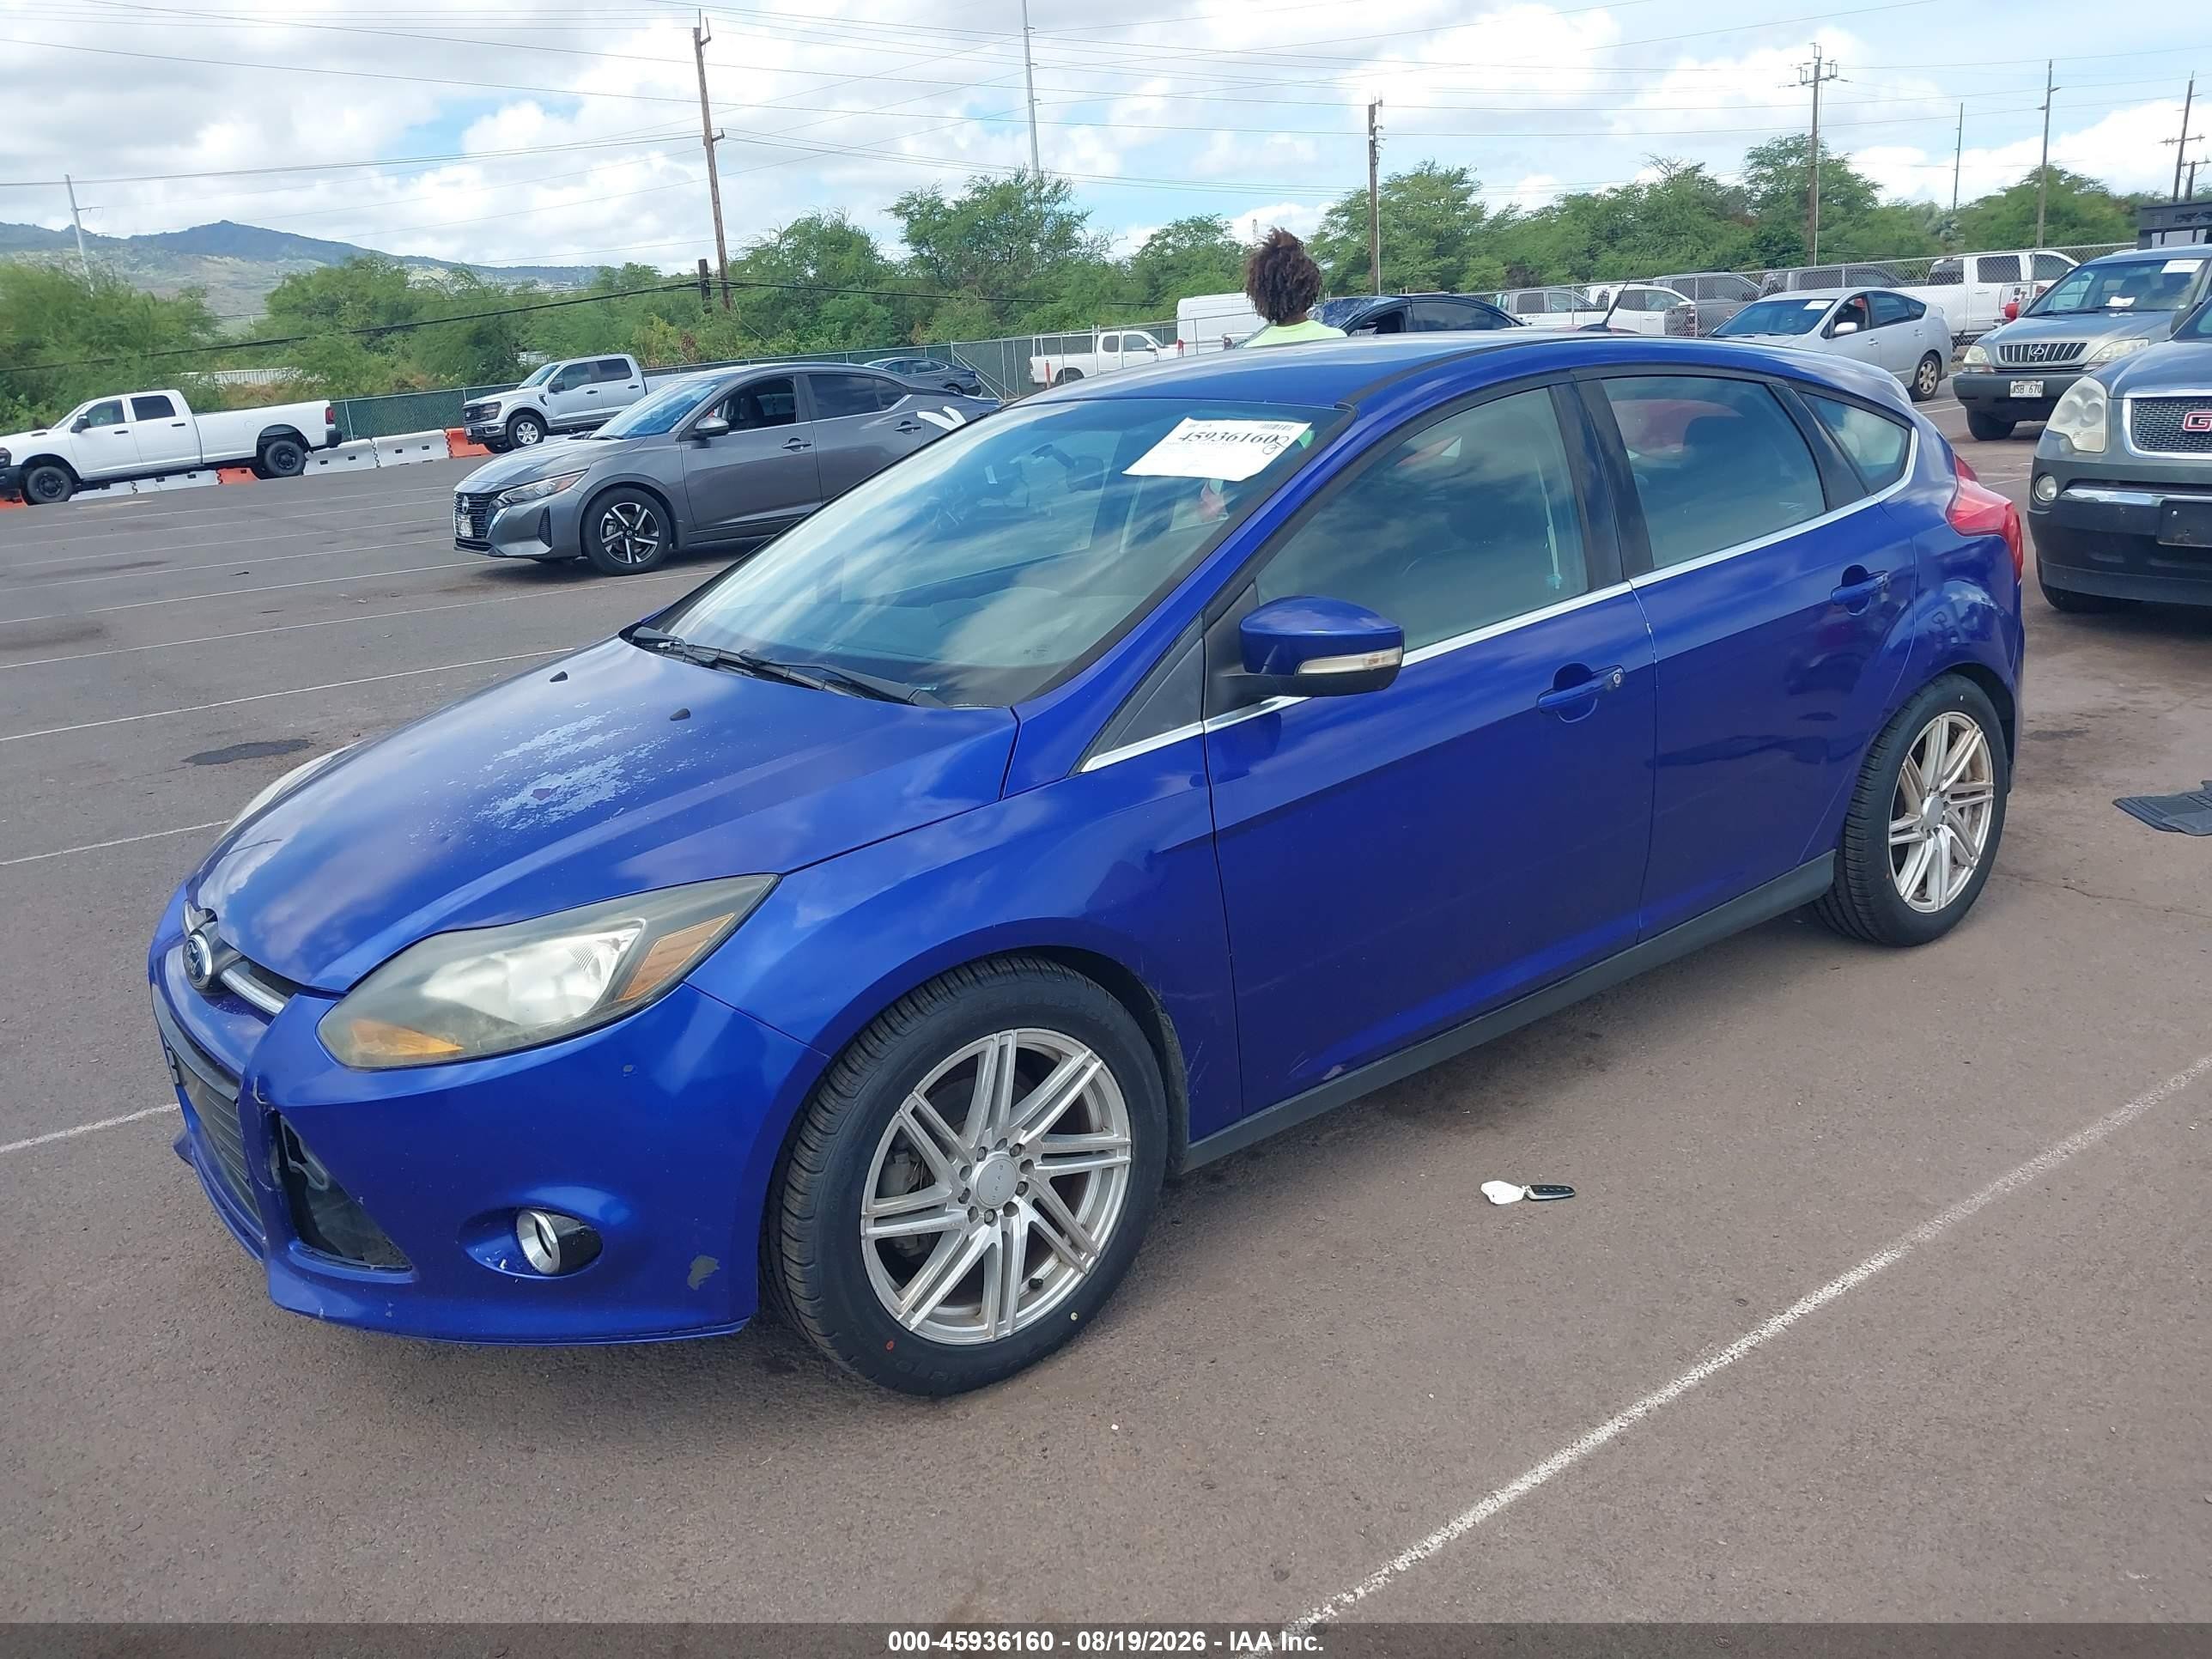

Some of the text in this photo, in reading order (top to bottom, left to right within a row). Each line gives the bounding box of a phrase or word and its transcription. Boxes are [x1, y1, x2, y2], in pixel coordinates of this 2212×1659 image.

[2011, 384, 2042, 394] JSB 670
[2183, 411, 2212, 432] G
